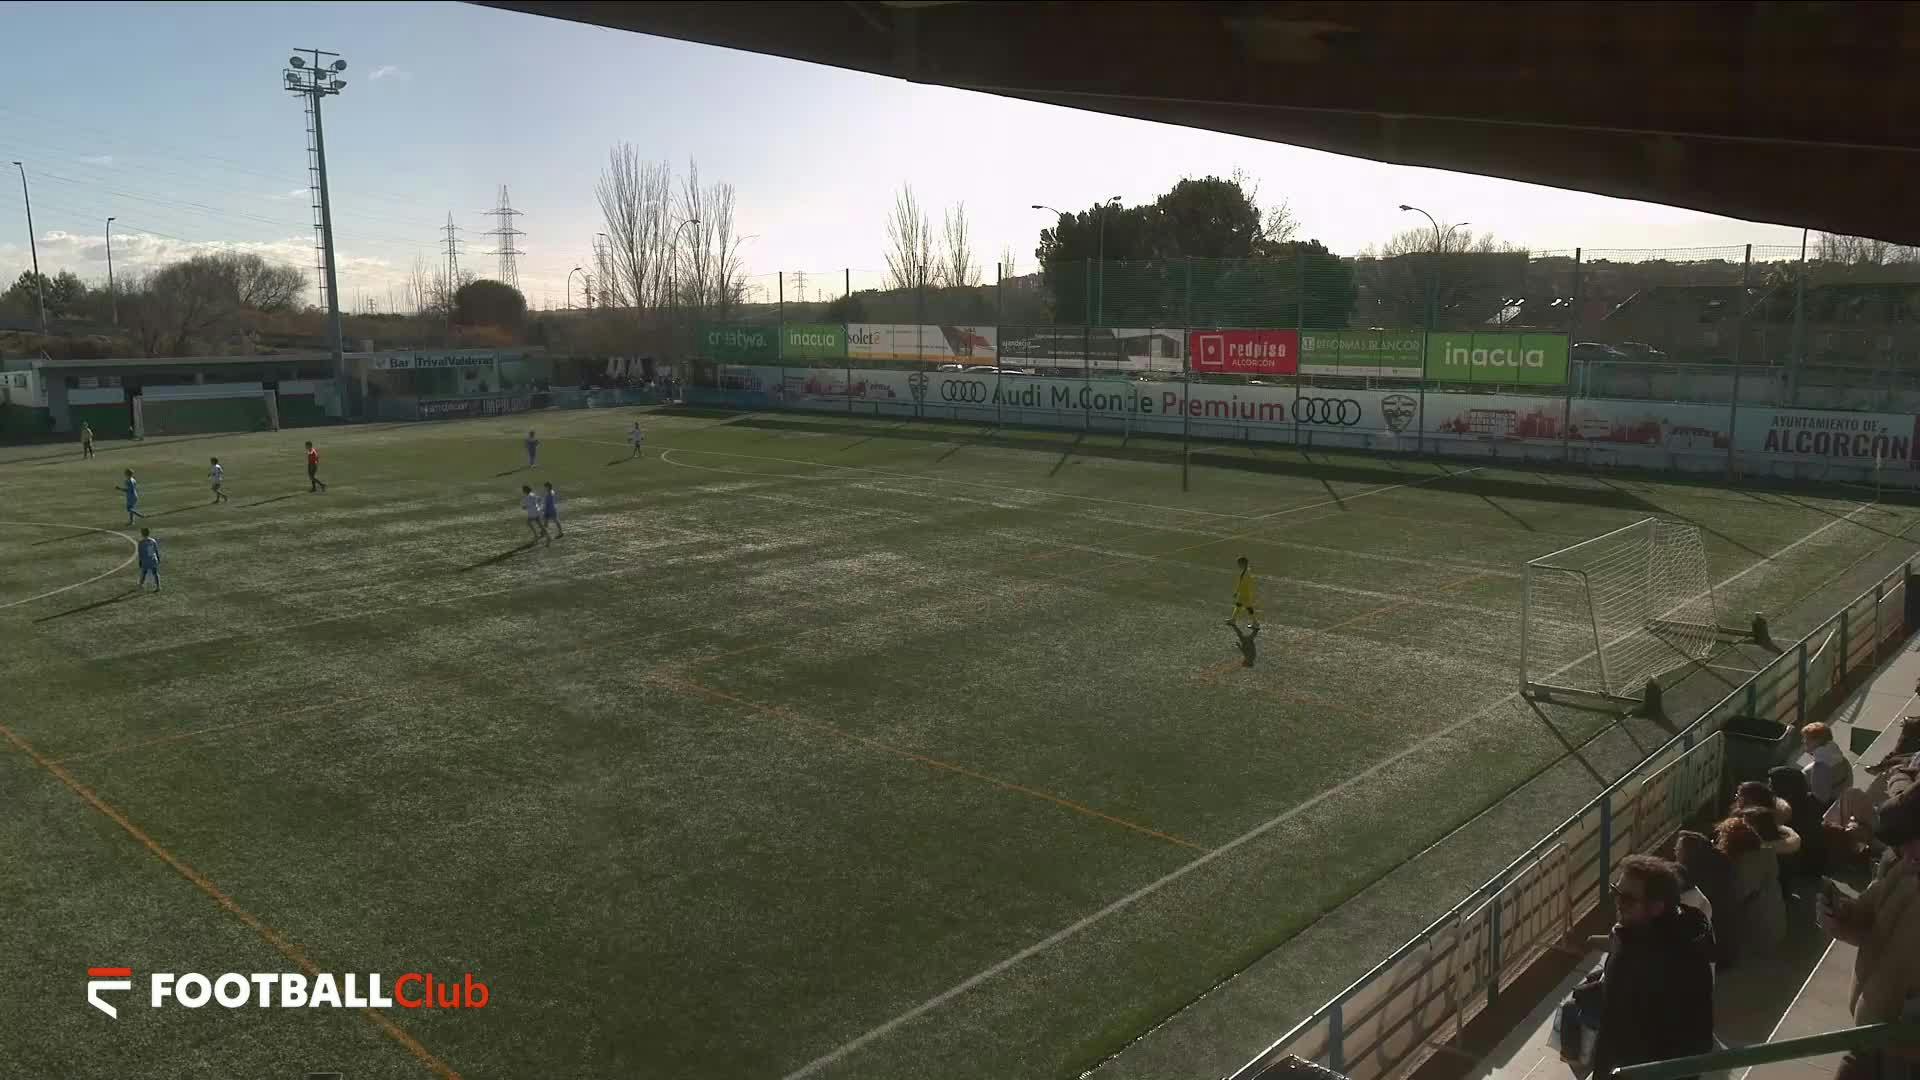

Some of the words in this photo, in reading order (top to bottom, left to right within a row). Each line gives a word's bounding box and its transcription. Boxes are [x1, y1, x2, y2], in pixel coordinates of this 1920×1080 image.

[790, 329, 835, 346] inacua
[1229, 341, 1286, 359] redpiso
[1445, 341, 1545, 368] inacua
[390, 357, 409, 369] Bar
[992, 384, 1041, 408] Audi
[1162, 391, 1285, 421] Premium
[1772, 415, 1859, 431] AYUNTAMIENTO
[1863, 420, 1881, 432] DE
[1764, 427, 1909, 459] ALCORCÓN
